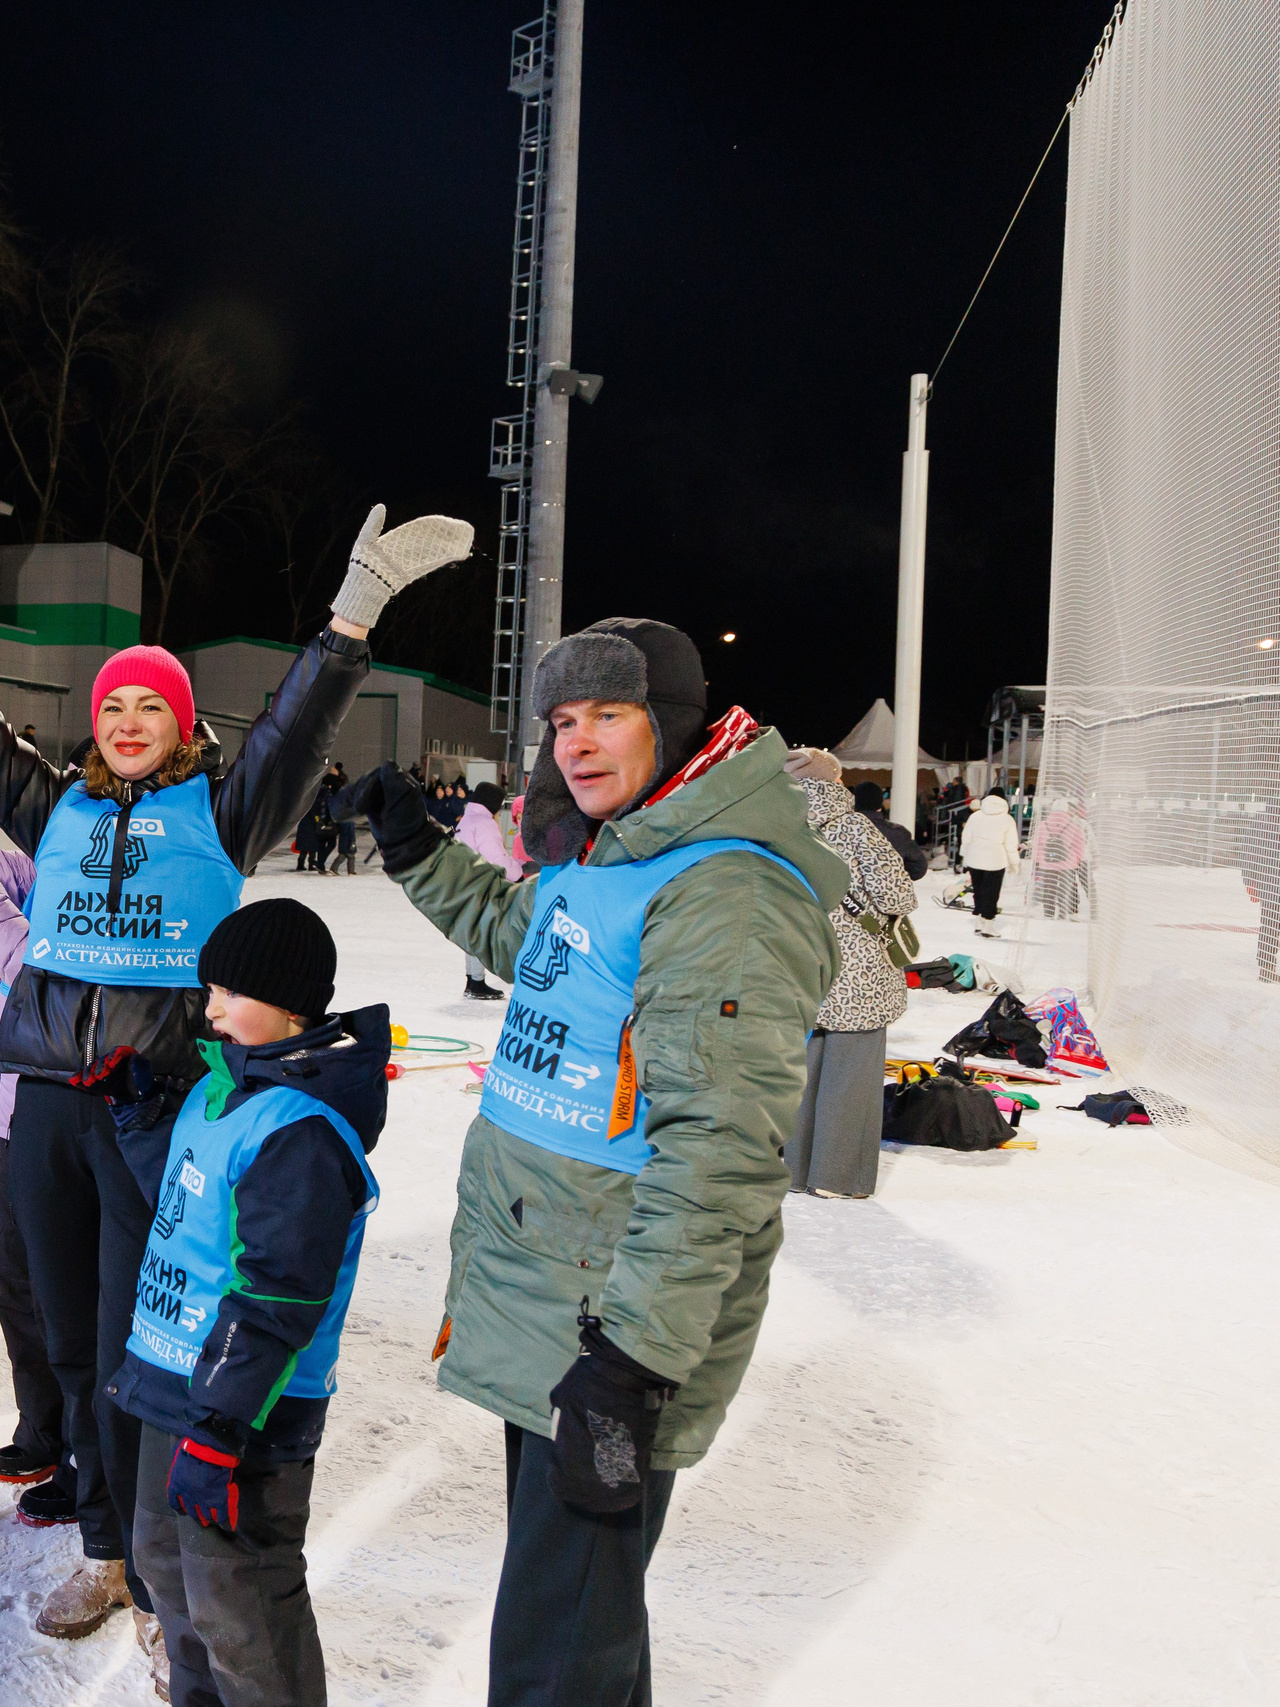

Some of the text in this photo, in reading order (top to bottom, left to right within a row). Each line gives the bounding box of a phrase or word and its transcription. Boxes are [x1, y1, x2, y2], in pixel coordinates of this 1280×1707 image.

[128, 820, 158, 833] 00
[57, 914, 161, 940] РОССИИ
[54, 948, 197, 969] АСТРАМЕД-МС
[616, 1051, 633, 1121] NORD STORM
